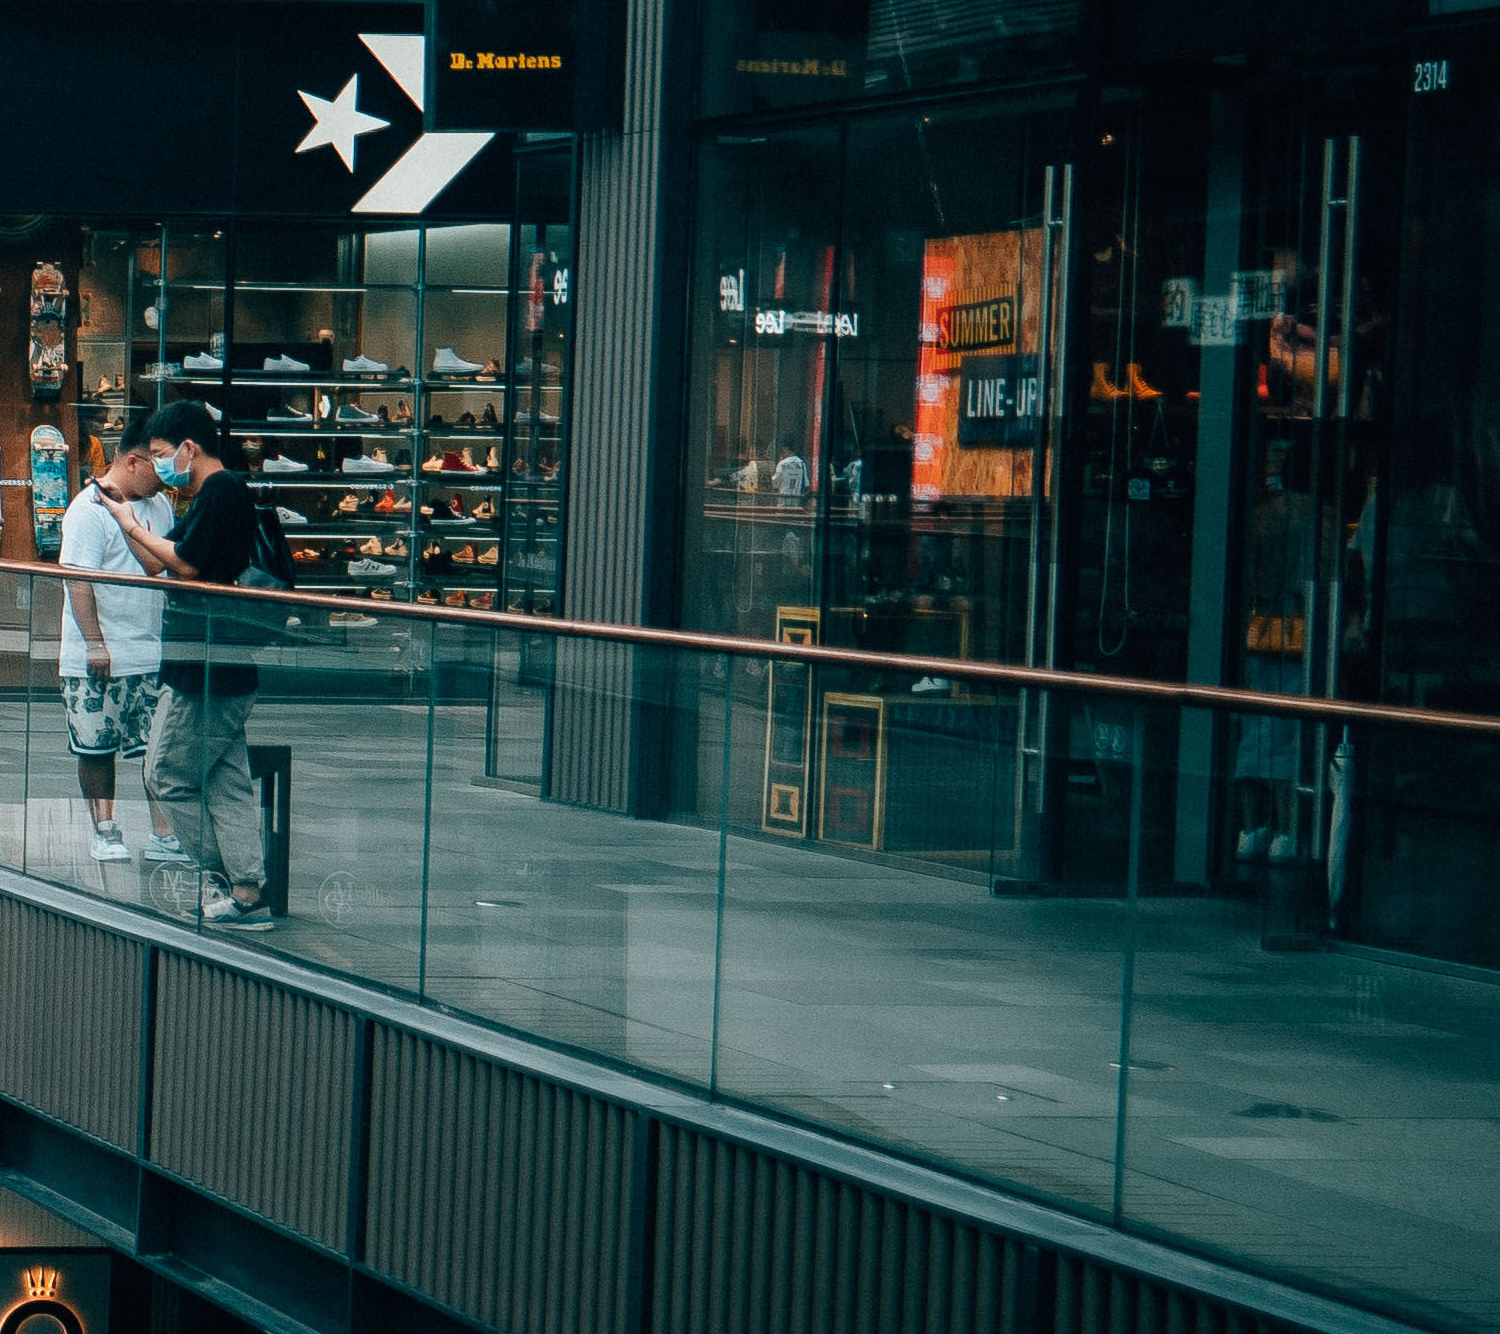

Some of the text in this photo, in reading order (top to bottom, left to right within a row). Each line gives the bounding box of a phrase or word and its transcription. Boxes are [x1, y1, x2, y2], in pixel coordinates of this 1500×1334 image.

[1414, 60, 1448, 92] 2314
[939, 300, 1011, 349] SUMMER
[966, 376, 1040, 418] LINE-UP
